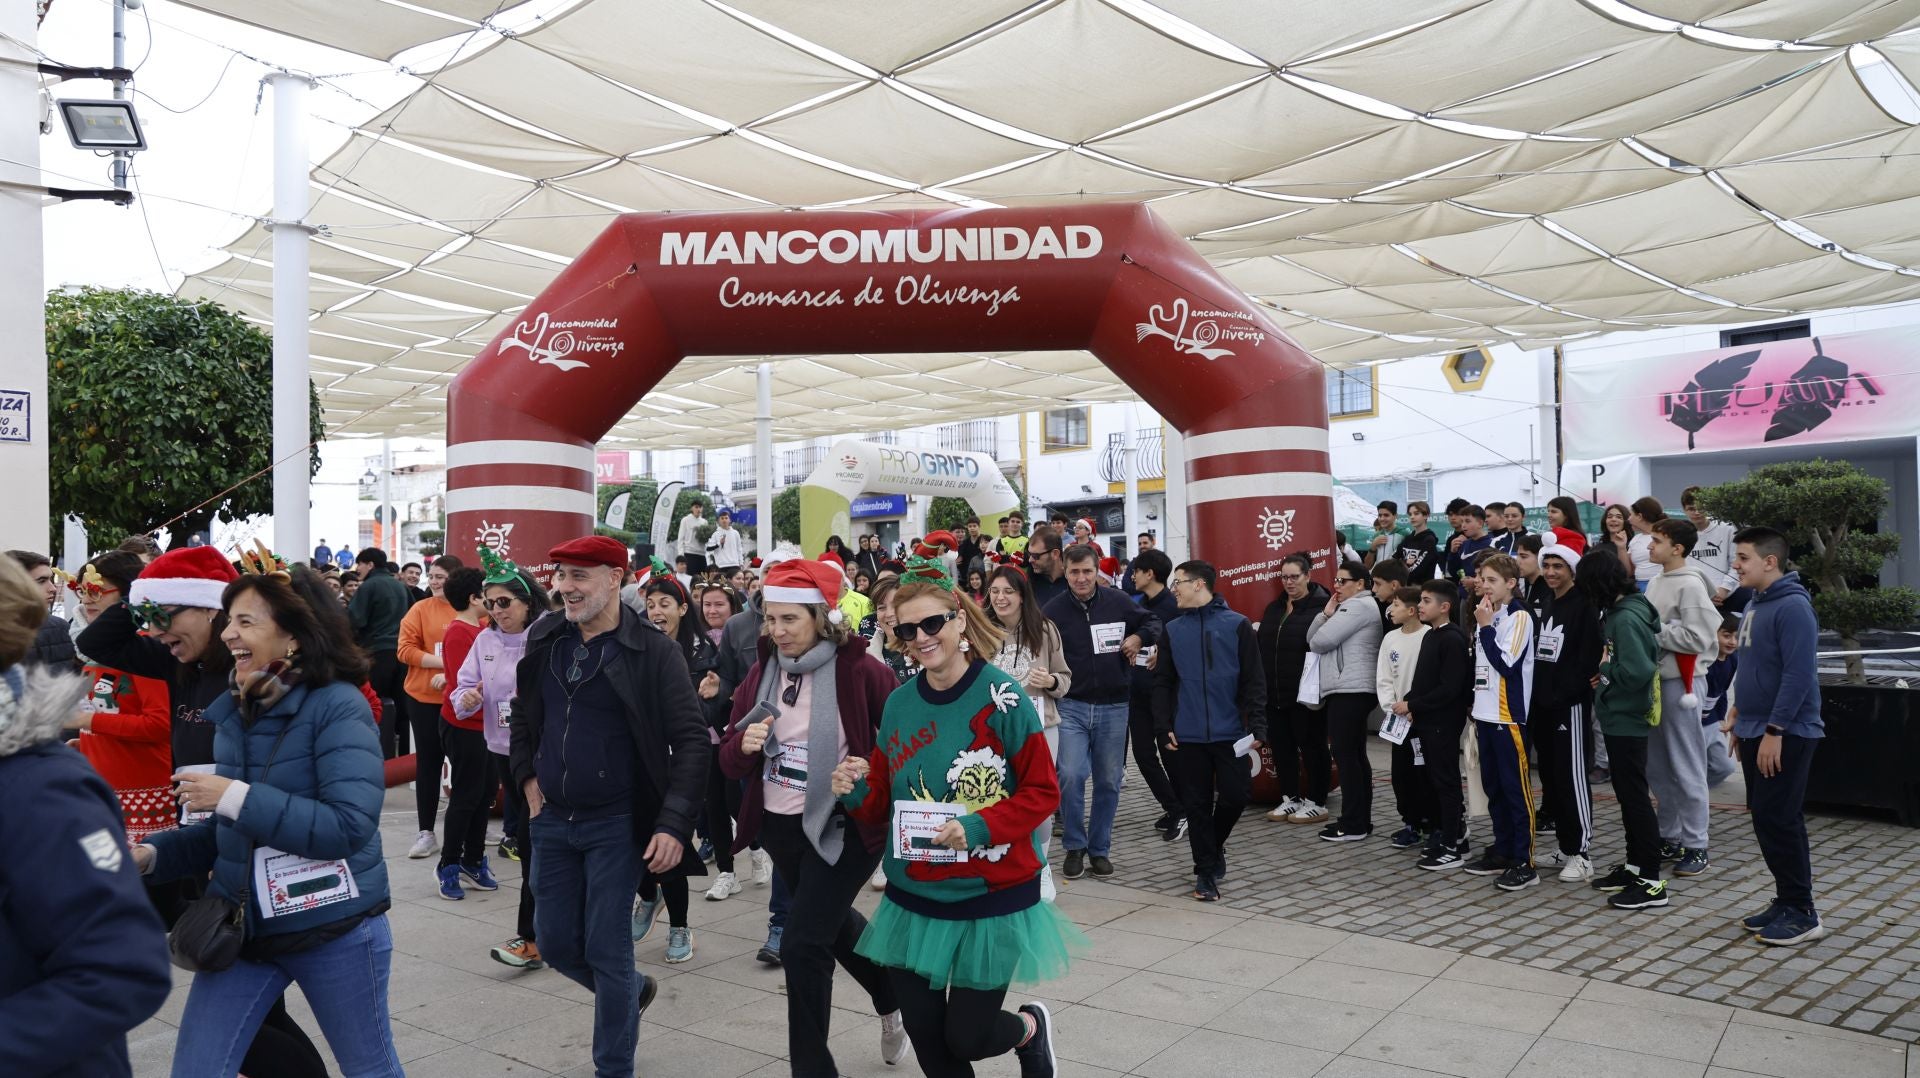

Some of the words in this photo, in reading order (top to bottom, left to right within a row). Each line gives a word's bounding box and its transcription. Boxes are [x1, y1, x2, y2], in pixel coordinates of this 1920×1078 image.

[659, 225, 1103, 266] MANCOMUNIDAD
[719, 277, 844, 308] Comarca
[853, 276, 884, 306] de
[895, 274, 1021, 316] Olivenza
[879, 448, 979, 478] PROGRIFO
[879, 474, 909, 484] EVENTOS
[910, 477, 924, 485] CON
[926, 479, 943, 487] AGUA
[945, 480, 956, 488] DEL
[958, 481, 977, 489] GRIFO
[1220, 561, 1266, 577] Deportistas
[1268, 558, 1282, 570] por
[1232, 575, 1254, 587] entre
[1255, 570, 1282, 582] Mujere
